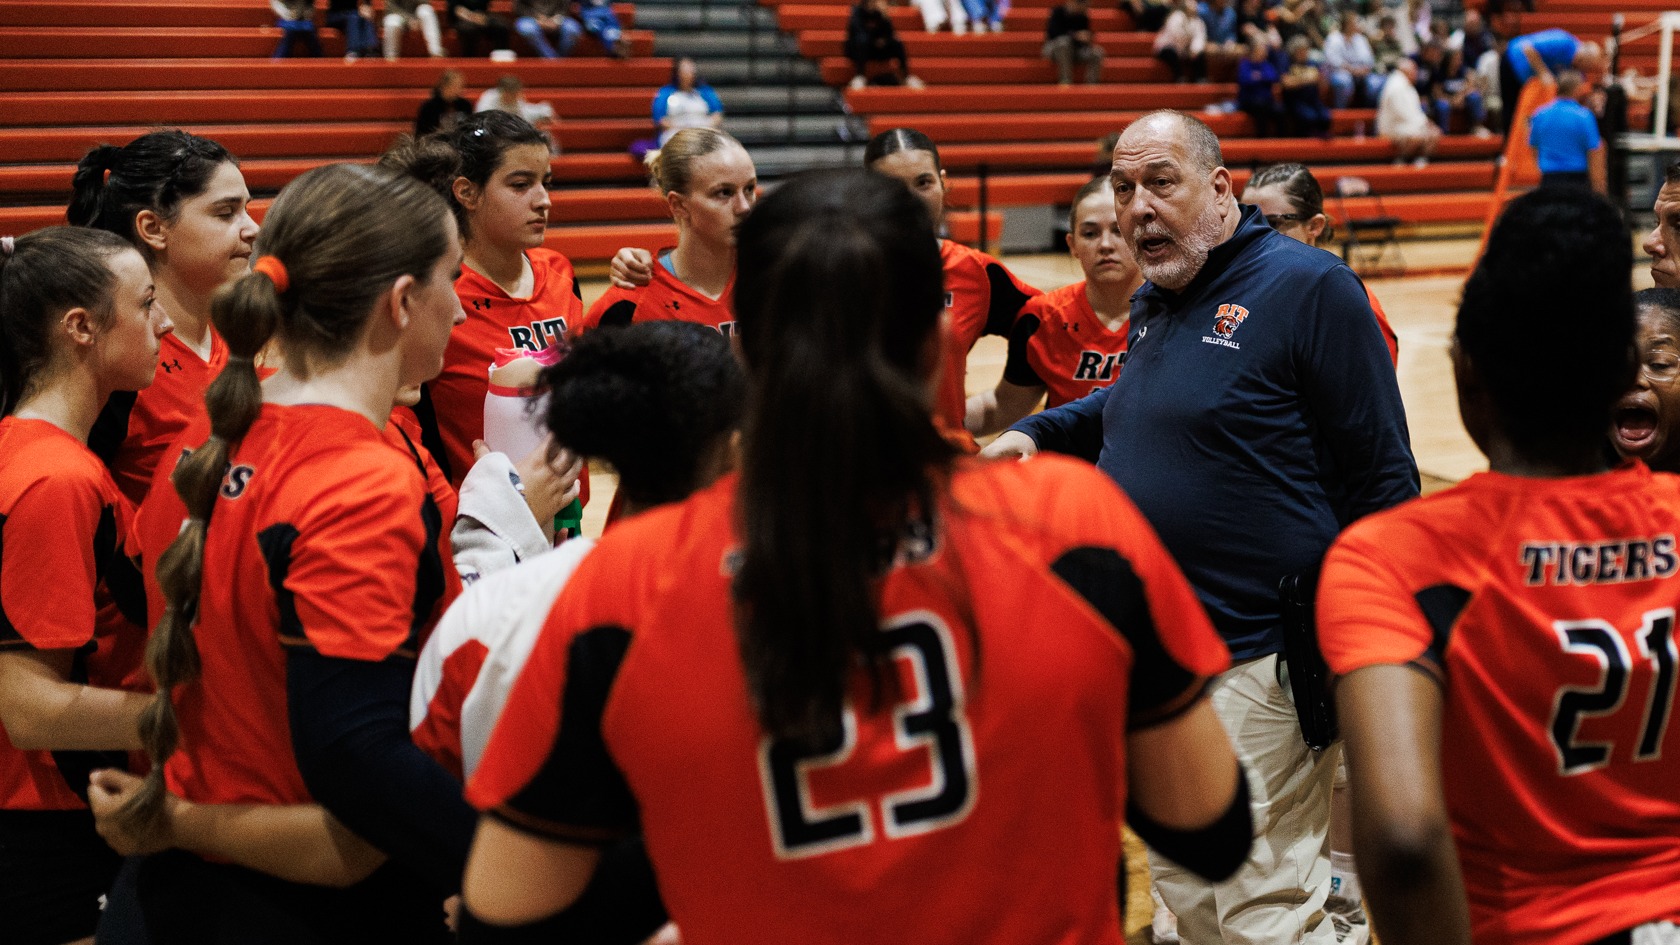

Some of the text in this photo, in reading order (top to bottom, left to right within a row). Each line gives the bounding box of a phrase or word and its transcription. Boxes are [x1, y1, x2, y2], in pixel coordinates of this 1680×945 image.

[1214, 303, 1250, 323] RIT
[508, 316, 568, 352] RIT
[1202, 336, 1240, 350] VOLLEYBALL
[1520, 533, 1680, 587] TIGERS
[1549, 606, 1680, 777] 21
